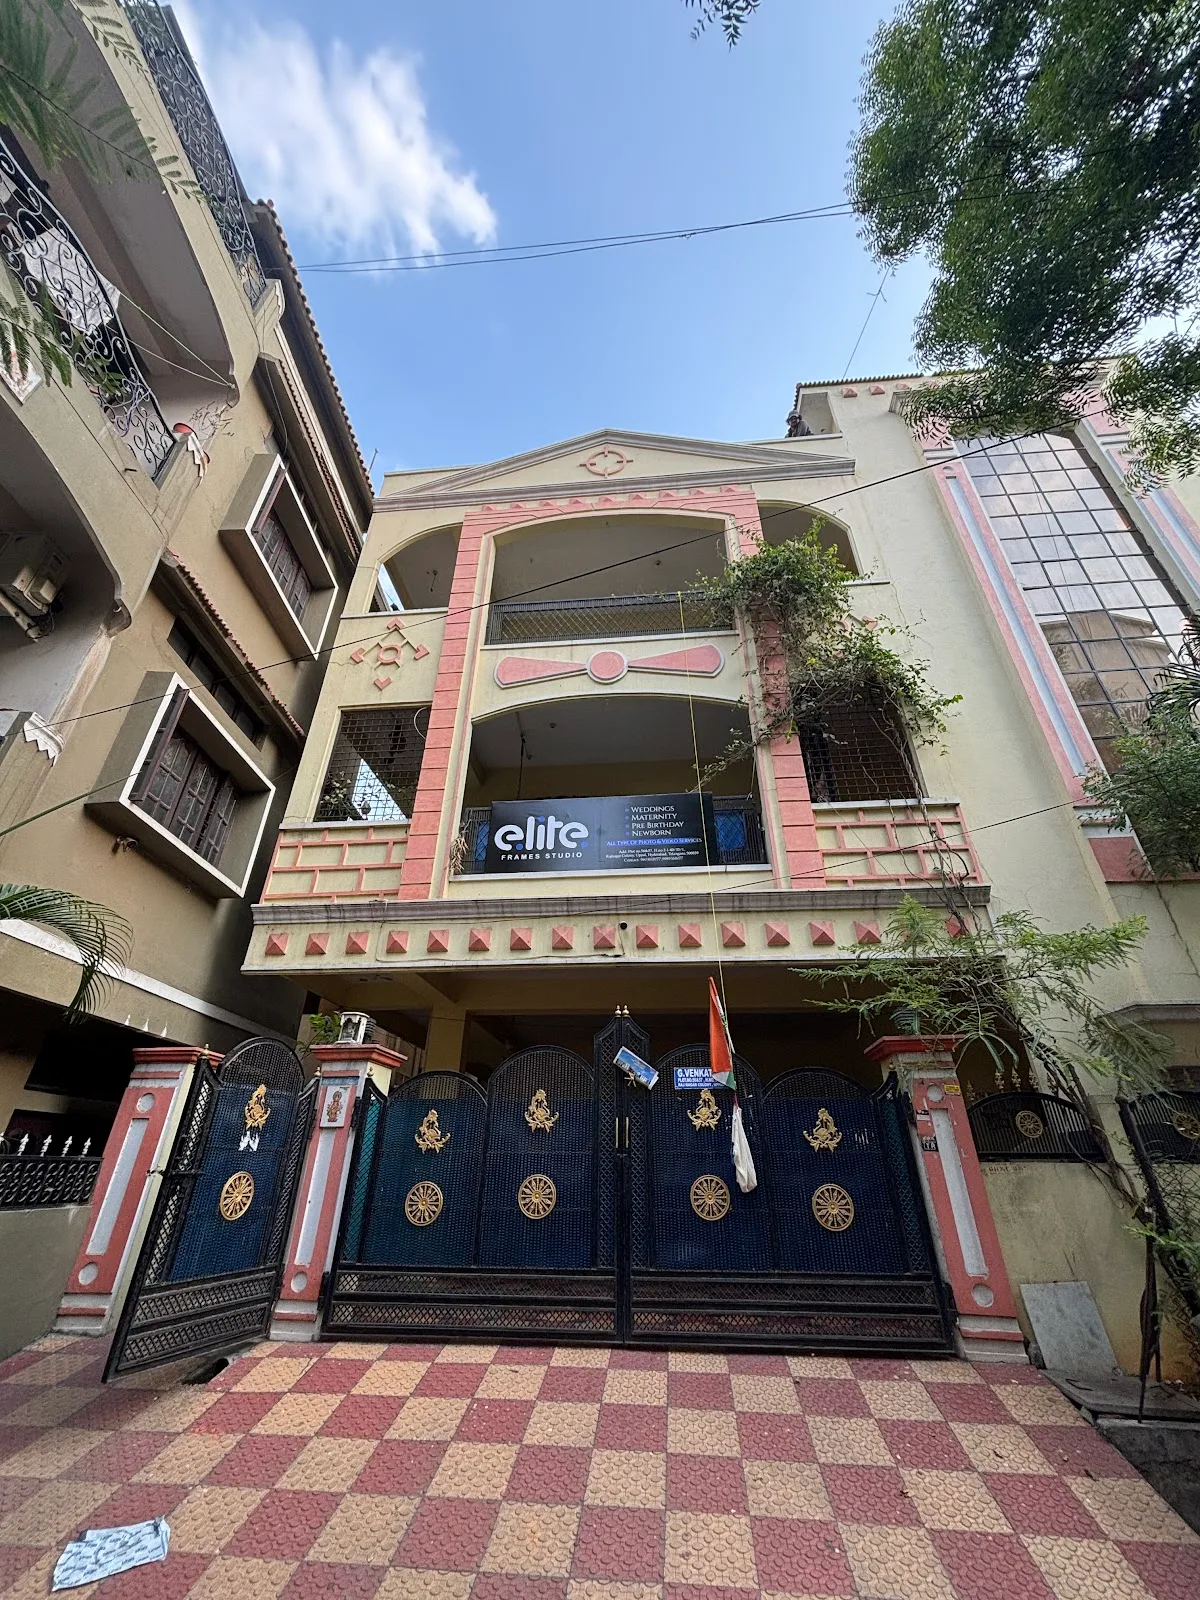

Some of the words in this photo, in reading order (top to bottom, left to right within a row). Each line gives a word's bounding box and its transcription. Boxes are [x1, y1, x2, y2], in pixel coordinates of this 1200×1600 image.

[631, 805, 675, 813] WEDDINGS
[631, 813, 678, 821] MATERNITY
[631, 822, 646, 830] PRE
[647, 821, 685, 829] BIRTHDAY
[494, 815, 589, 851] elite
[632, 829, 672, 837] NEWBORN
[501, 853, 541, 861] FRAMES
[545, 851, 583, 860] STUDIO
